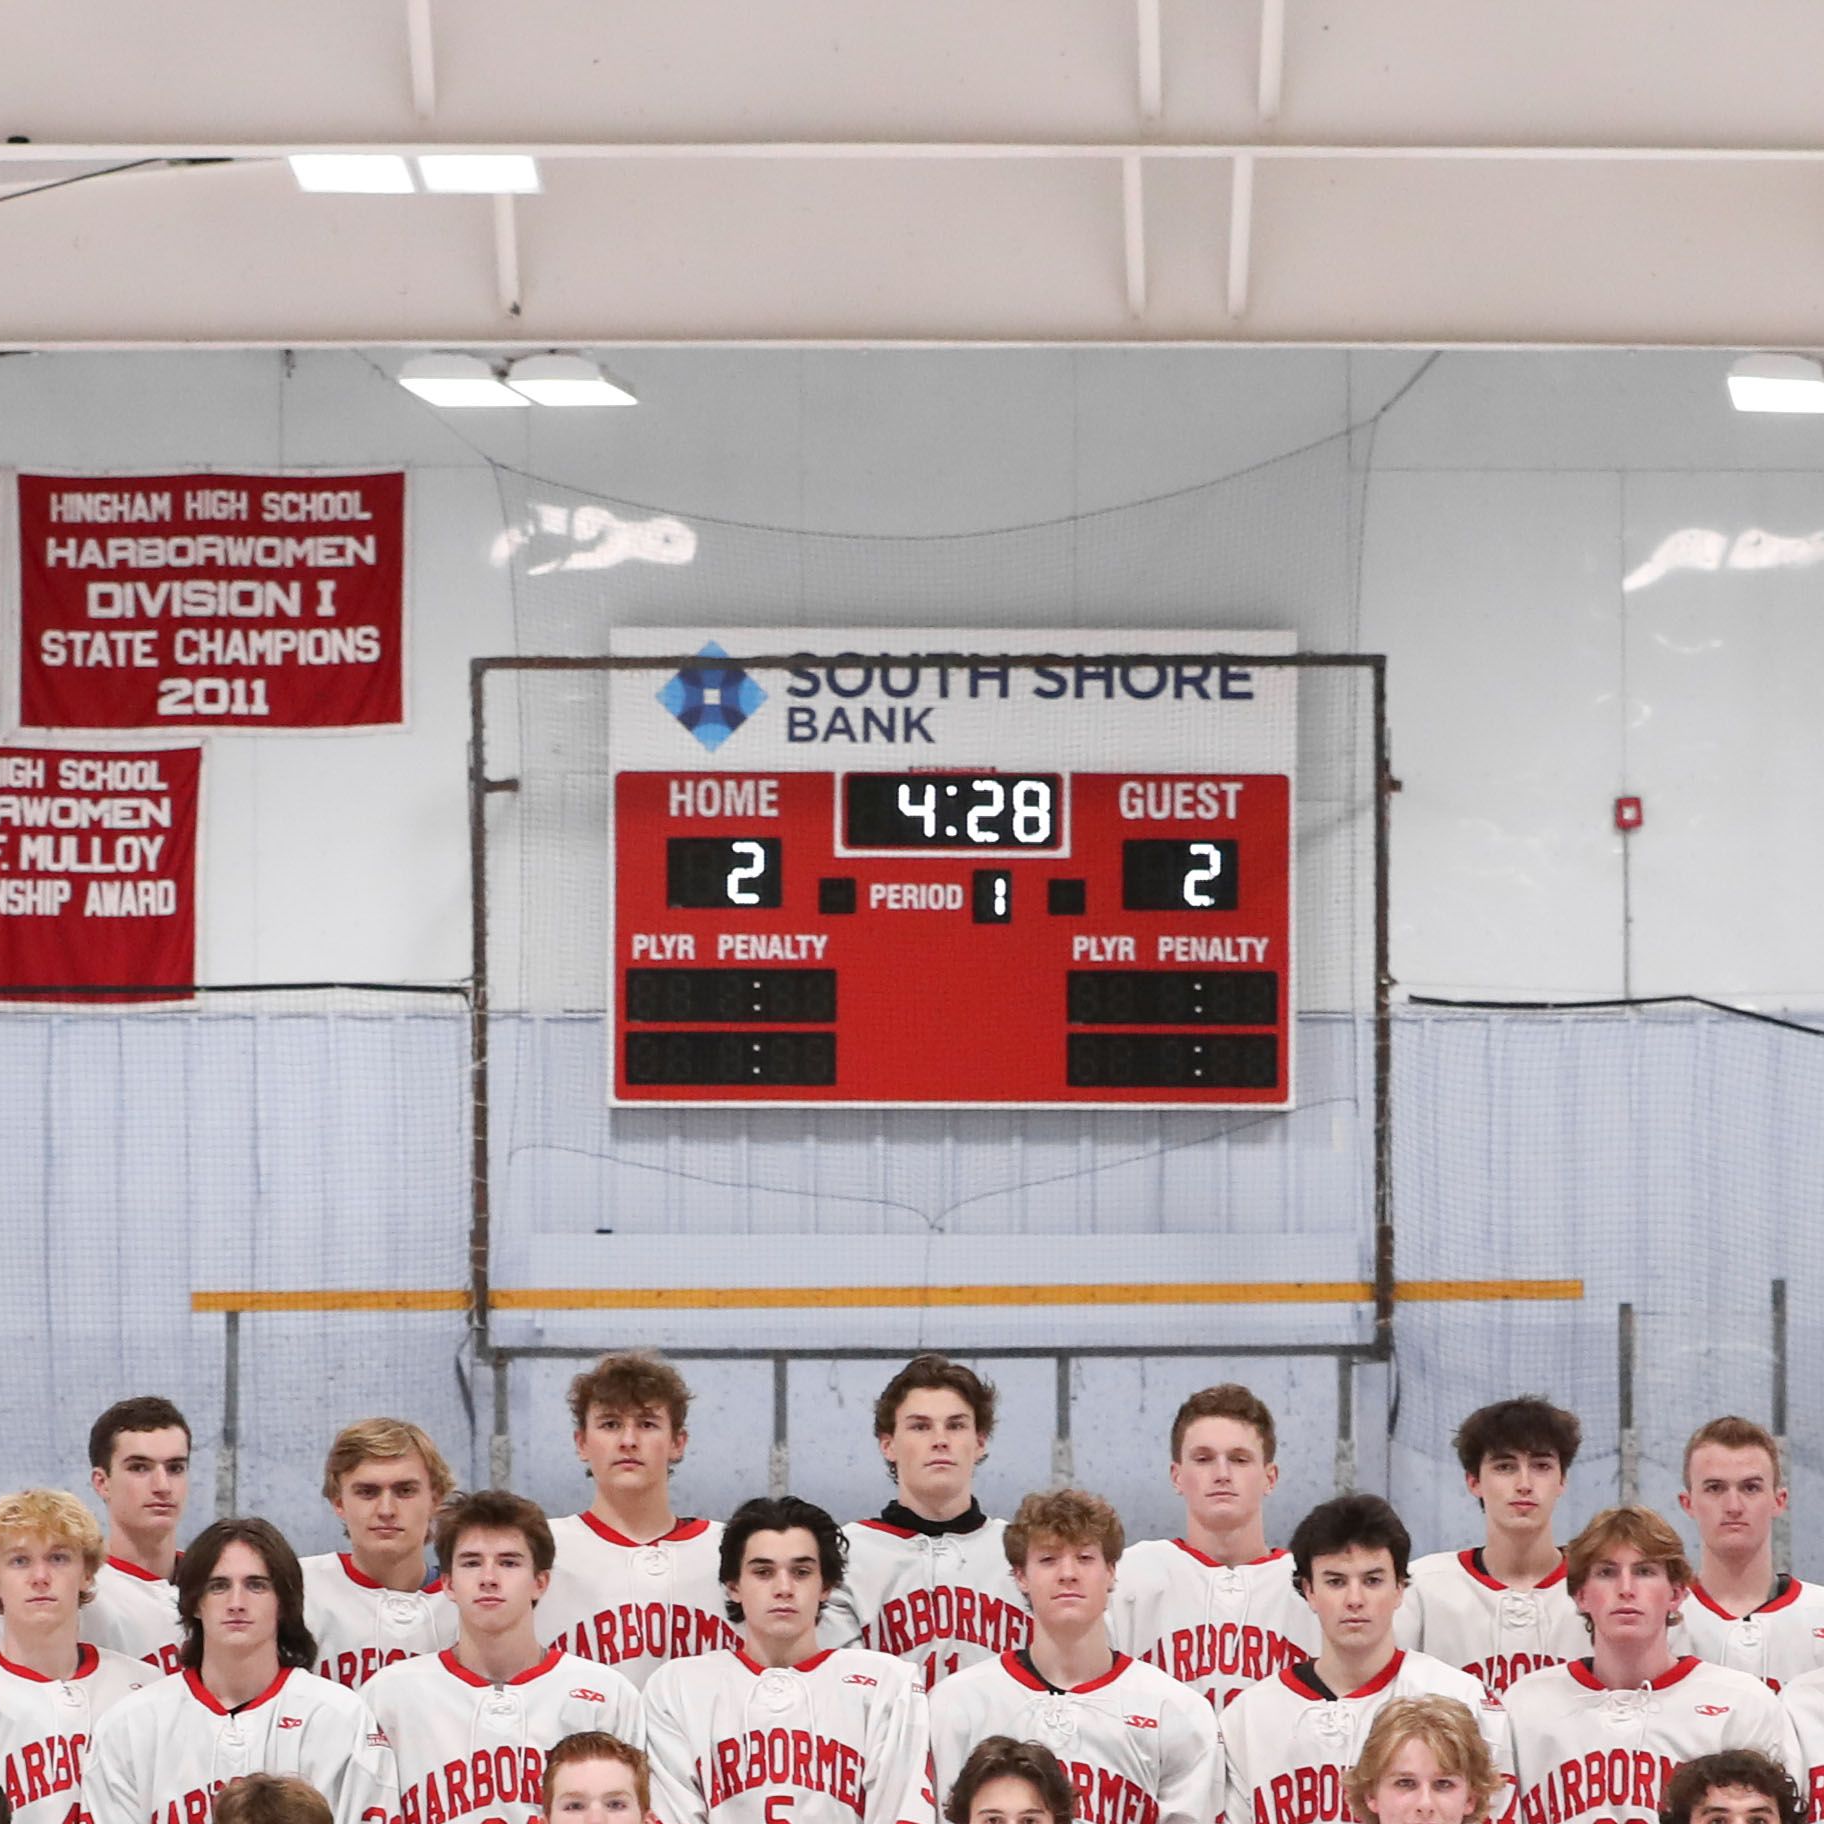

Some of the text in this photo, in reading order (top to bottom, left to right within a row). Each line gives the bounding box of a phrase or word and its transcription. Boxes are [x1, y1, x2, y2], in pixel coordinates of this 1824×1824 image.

[51, 490, 372, 523] HINGHAM HIGH SCHOOL
[47, 535, 376, 568] HARBORWOMEN
[87, 580, 336, 618] DIVISION I
[42, 626, 380, 667] STATE CHAMPIONS
[786, 654, 1254, 699] SOUTH SHORE
[158, 678, 269, 715] 2011
[787, 705, 936, 743] BANK
[59, 759, 168, 791] SCHOOL
[670, 779, 778, 817] HOME
[899, 780, 1050, 842] 4:28
[1119, 781, 1243, 819] GUEST
[20, 835, 164, 873] MULLOY
[727, 842, 764, 904] 2
[1184, 844, 1220, 906] 2
[84, 880, 176, 916] AWARD
[870, 879, 1006, 915] PERIOD 1
[632, 934, 827, 960] PLYR PENALTY
[1073, 936, 1269, 962] PLYR PENALTY
[862, 1585, 1034, 1655] ARBORME
[695, 1727, 866, 1818] ARBORME
